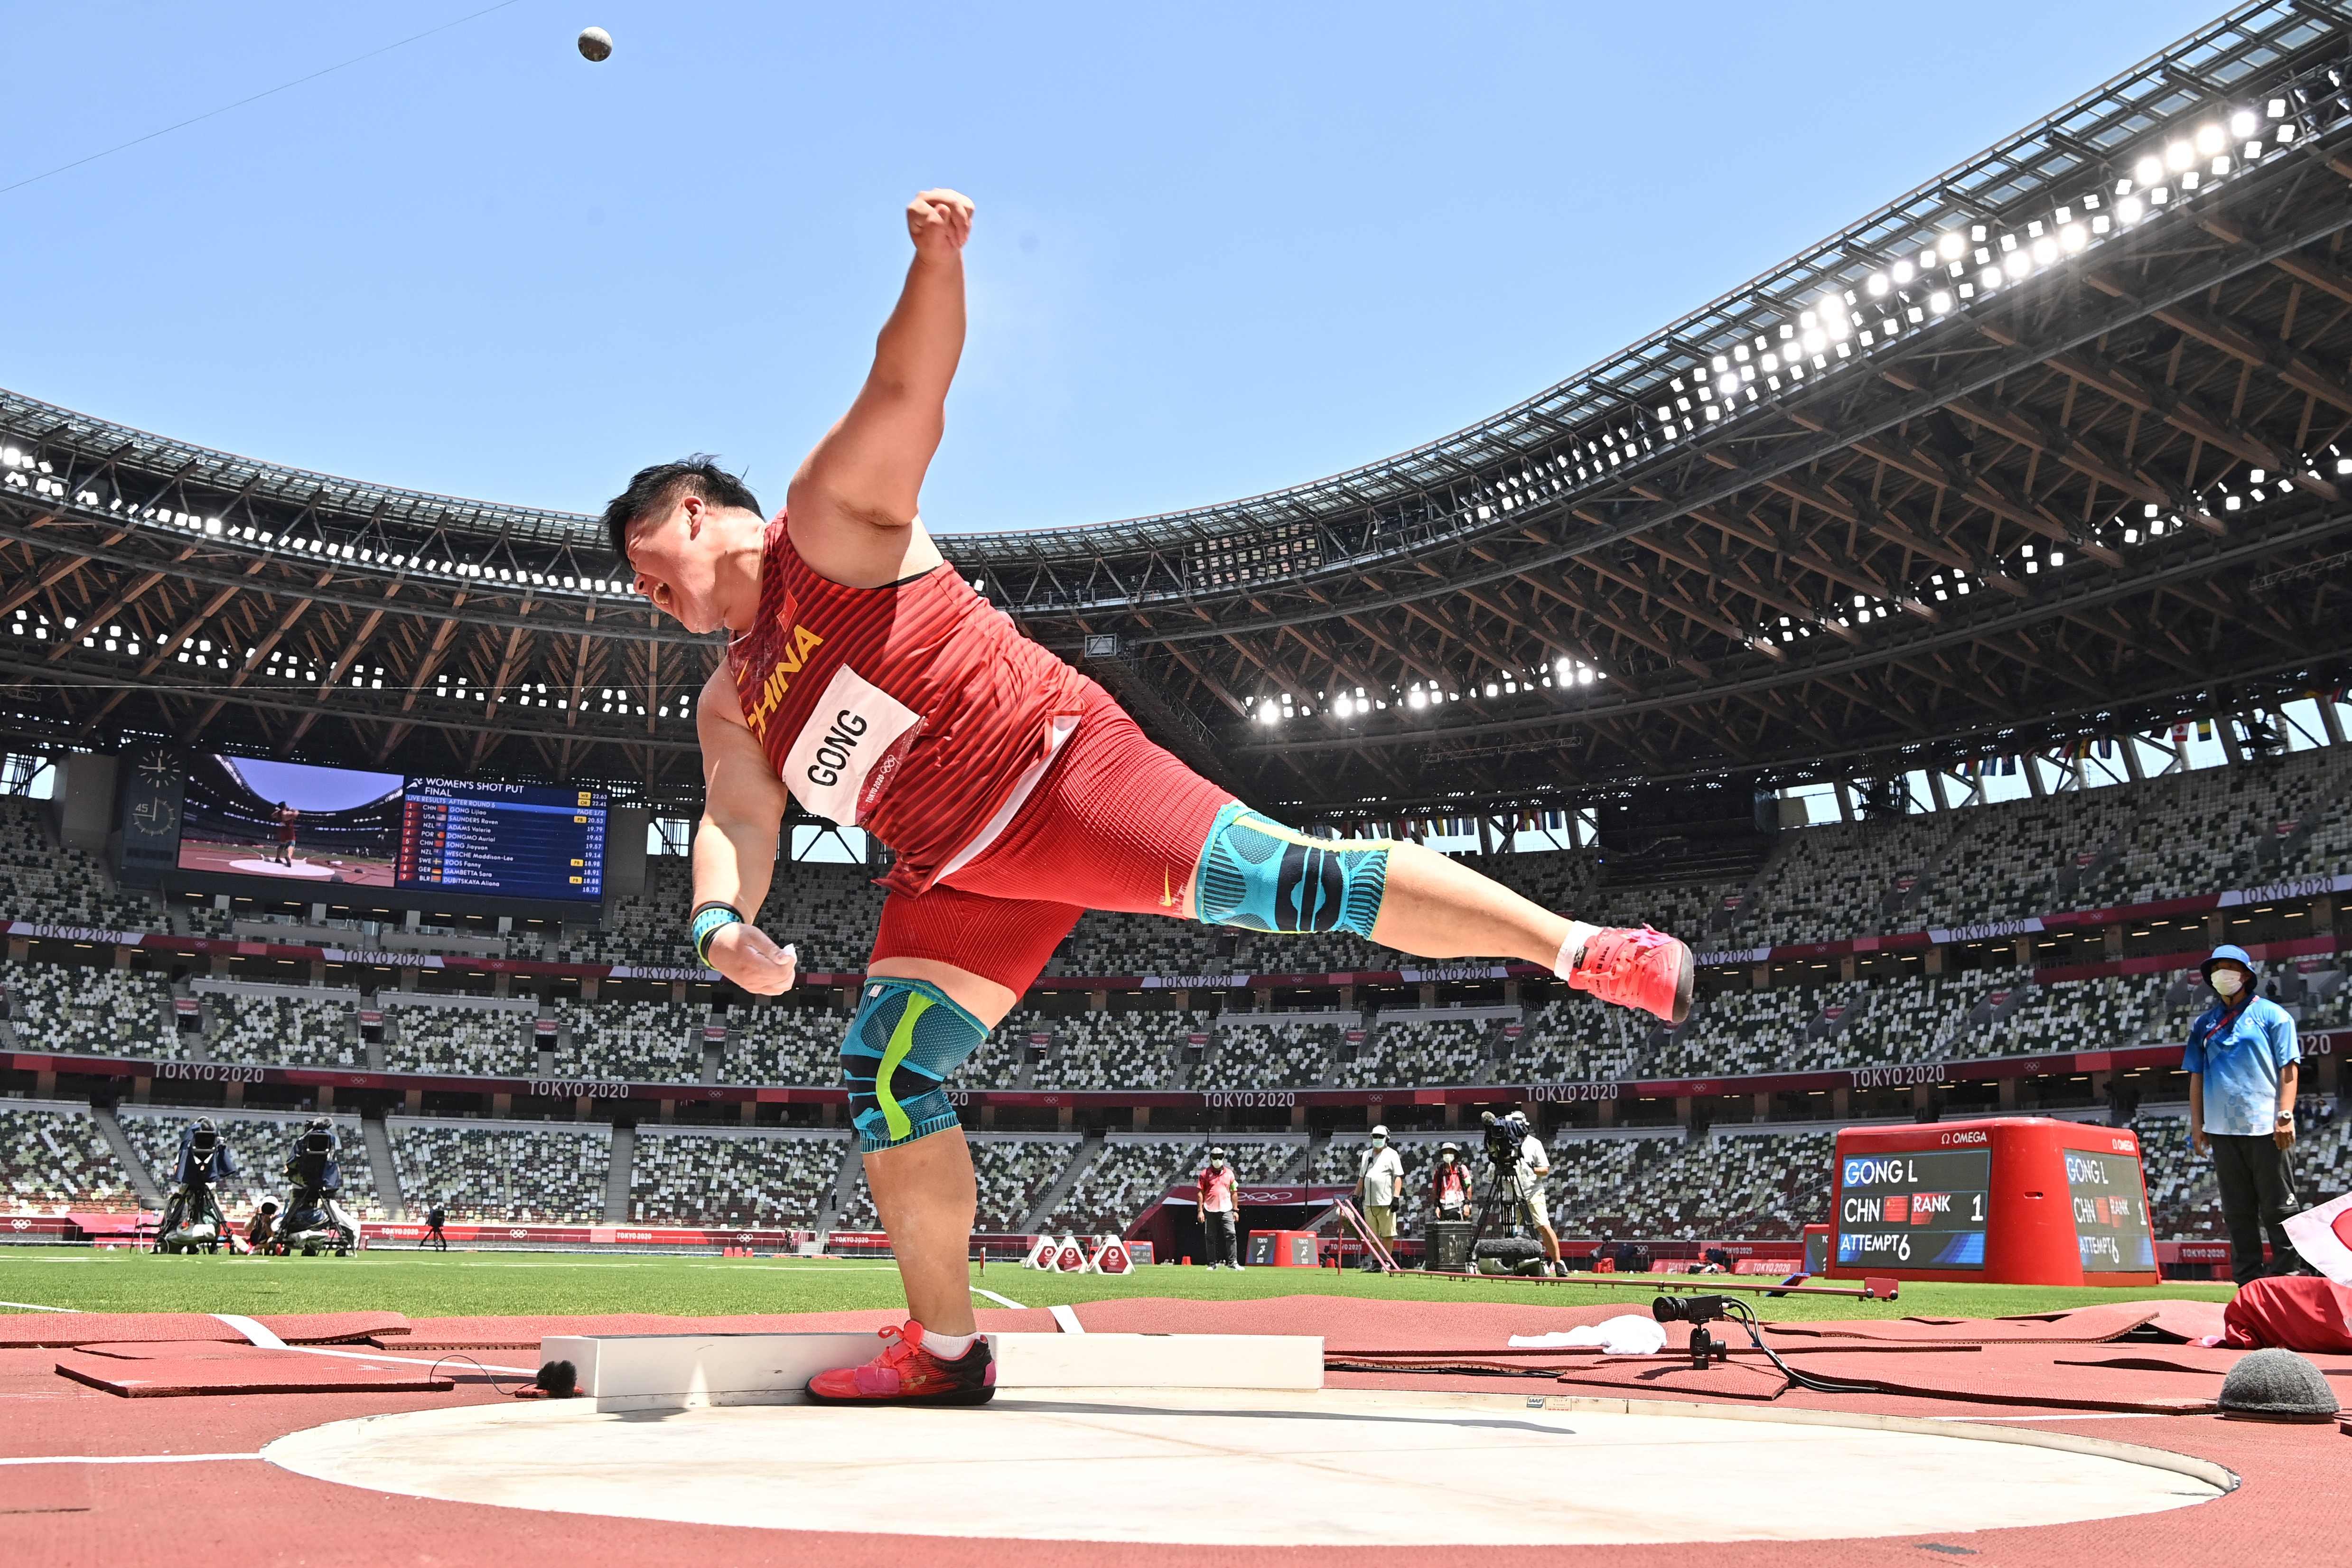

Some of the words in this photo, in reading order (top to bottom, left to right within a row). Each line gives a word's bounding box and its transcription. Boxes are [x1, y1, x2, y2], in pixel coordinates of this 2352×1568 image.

[807, 709, 867, 786] GONG
[425, 787, 452, 797] FINAL
[426, 777, 474, 790] WOMEN'S
[476, 782, 503, 792] SHOT
[505, 784, 524, 793] PUT
[865, 784, 878, 803] TOKYO
[873, 774, 885, 790] 2020
[135, 803, 149, 813] 45
[448, 798, 468, 806] AFTER
[448, 815, 480, 823] SAUNDERS
[447, 833, 477, 841] DONGMO
[466, 843, 488, 851] Jiayuan
[446, 850, 471, 859] WESCHE
[473, 853, 513, 861] Maddison-Lee
[444, 868, 478, 877] GAMBETTA
[443, 877, 480, 886] DUBITSKAYA
[2239, 883, 2290, 904] TOKYO
[2294, 877, 2334, 896] 2020
[31, 923, 81, 940] TOKYO
[86, 928, 122, 944] 2020
[1948, 924, 1990, 942] TOKYO
[1994, 919, 2025, 937] 2020
[343, 949, 388, 964] TOKYO
[392, 952, 425, 967] 2020
[1693, 951, 1720, 965] KYO
[1723, 949, 1754, 962] 2020
[629, 967, 672, 979] TOKYO
[675, 968, 706, 980] 2020
[1159, 976, 1199, 988] TOKYO
[1202, 975, 1232, 987] 2020
[1418, 969, 1458, 982] TOKYO
[1462, 967, 1492, 980] 2020
[2298, 1035, 2331, 1055] 020
[153, 1063, 215, 1081] TOKYO
[219, 1067, 264, 1083] 2020
[1850, 1068, 1902, 1087] TOKYO
[1906, 1064, 1944, 1084] 2020
[528, 1081, 584, 1097] TOKYO
[588, 1084, 629, 1099] 2020
[1526, 1085, 1576, 1101] TOKYO
[1580, 1084, 1618, 1101] 2020
[946, 1092, 969, 1106] 20
[1203, 1092, 1253, 1107] TOKYO
[1258, 1092, 1295, 1108] 2020
[1952, 1131, 1988, 1144] OMEGA
[1845, 1160, 1903, 1185] GONG
[1908, 1159, 1918, 1183] L
[2066, 1157, 2100, 1184] GONG
[2100, 1161, 2109, 1185] L
[1844, 1197, 1880, 1223] CHN
[1913, 1195, 1951, 1213] RANK
[1971, 1193, 1984, 1222] 1
[2073, 1196, 2097, 1223] CHN
[2109, 1198, 2130, 1215] RANK
[2137, 1200, 2147, 1225] 1
[1840, 1235, 1899, 1251] ATTEMPT
[1898, 1234, 1911, 1261] 6
[2080, 1236, 2111, 1254] ATTEMPT
[2111, 1236, 2119, 1264] 6
[2182, 1249, 2206, 1257] TOKYO
[2207, 1249, 2225, 1258] 2020
[1754, 1263, 1773, 1272] TOKYO
[1773, 1263, 1791, 1272] 2020
